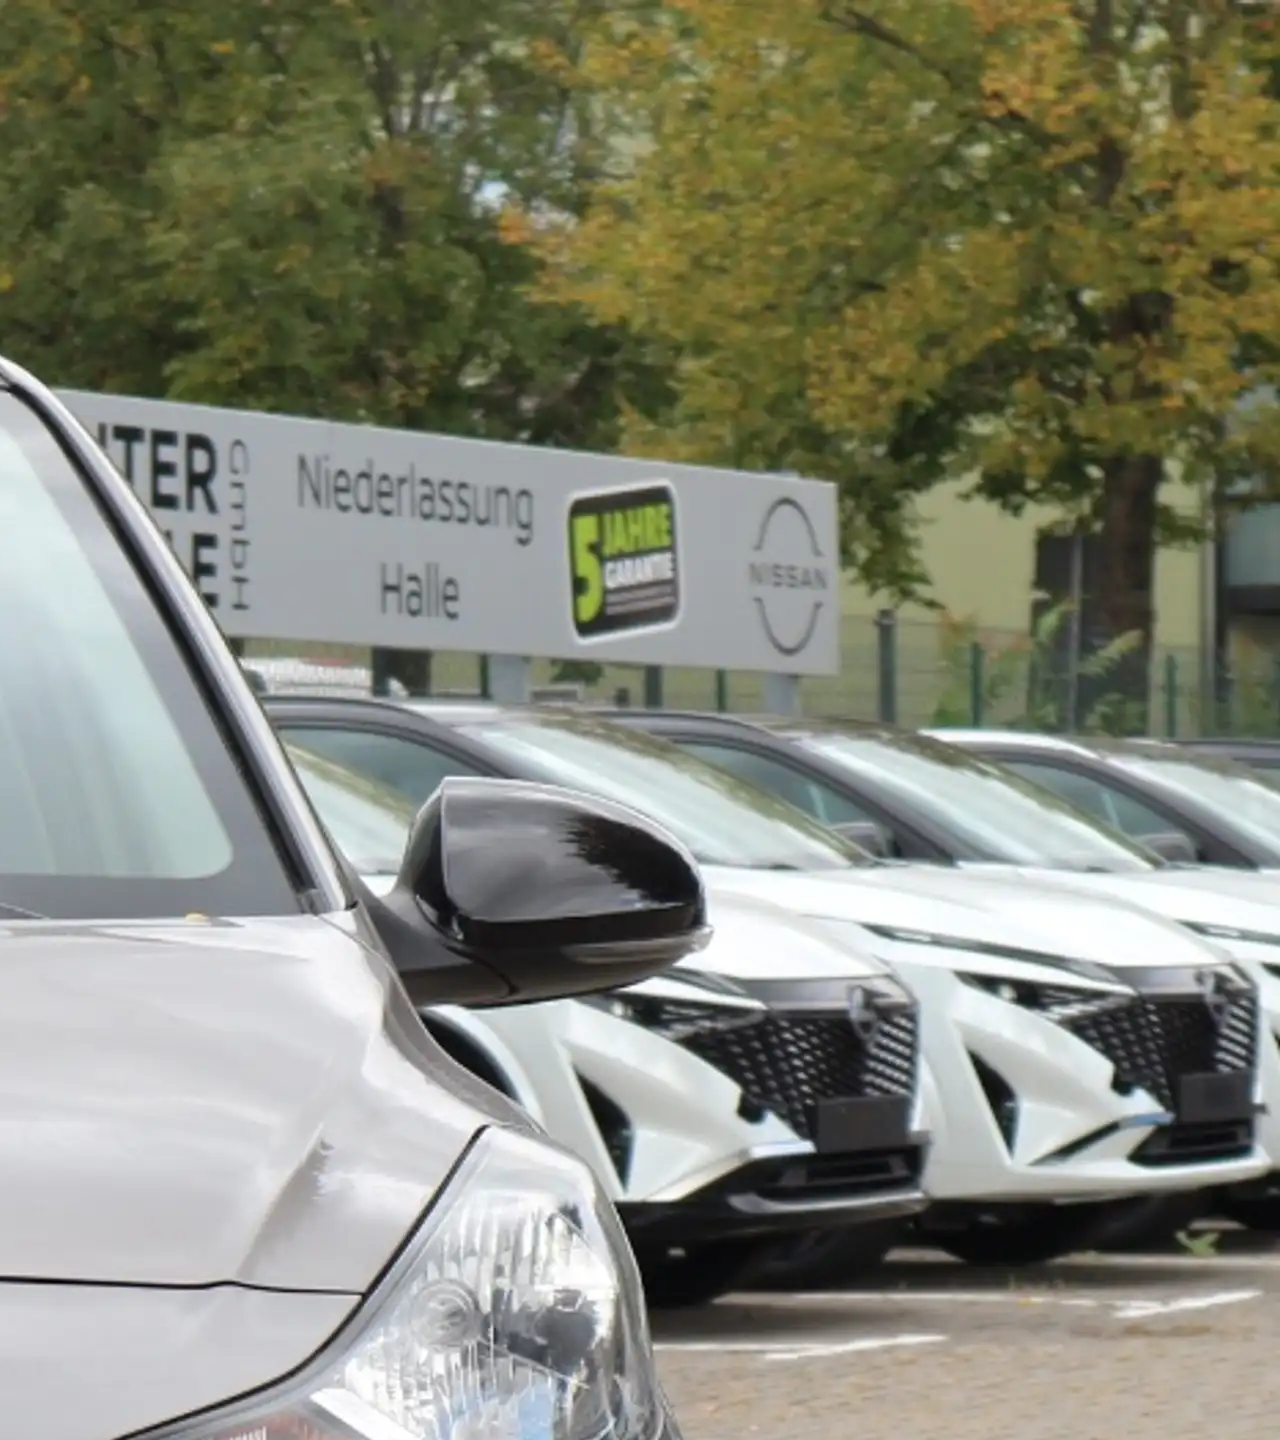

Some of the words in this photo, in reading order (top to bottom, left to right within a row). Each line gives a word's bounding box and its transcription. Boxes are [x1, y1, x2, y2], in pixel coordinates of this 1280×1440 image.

[98, 422, 218, 515] TER
[297, 453, 535, 547] Niederlassung
[379, 562, 460, 621] Halle
[572, 515, 603, 624] 5
[748, 562, 828, 589] NISSAN
